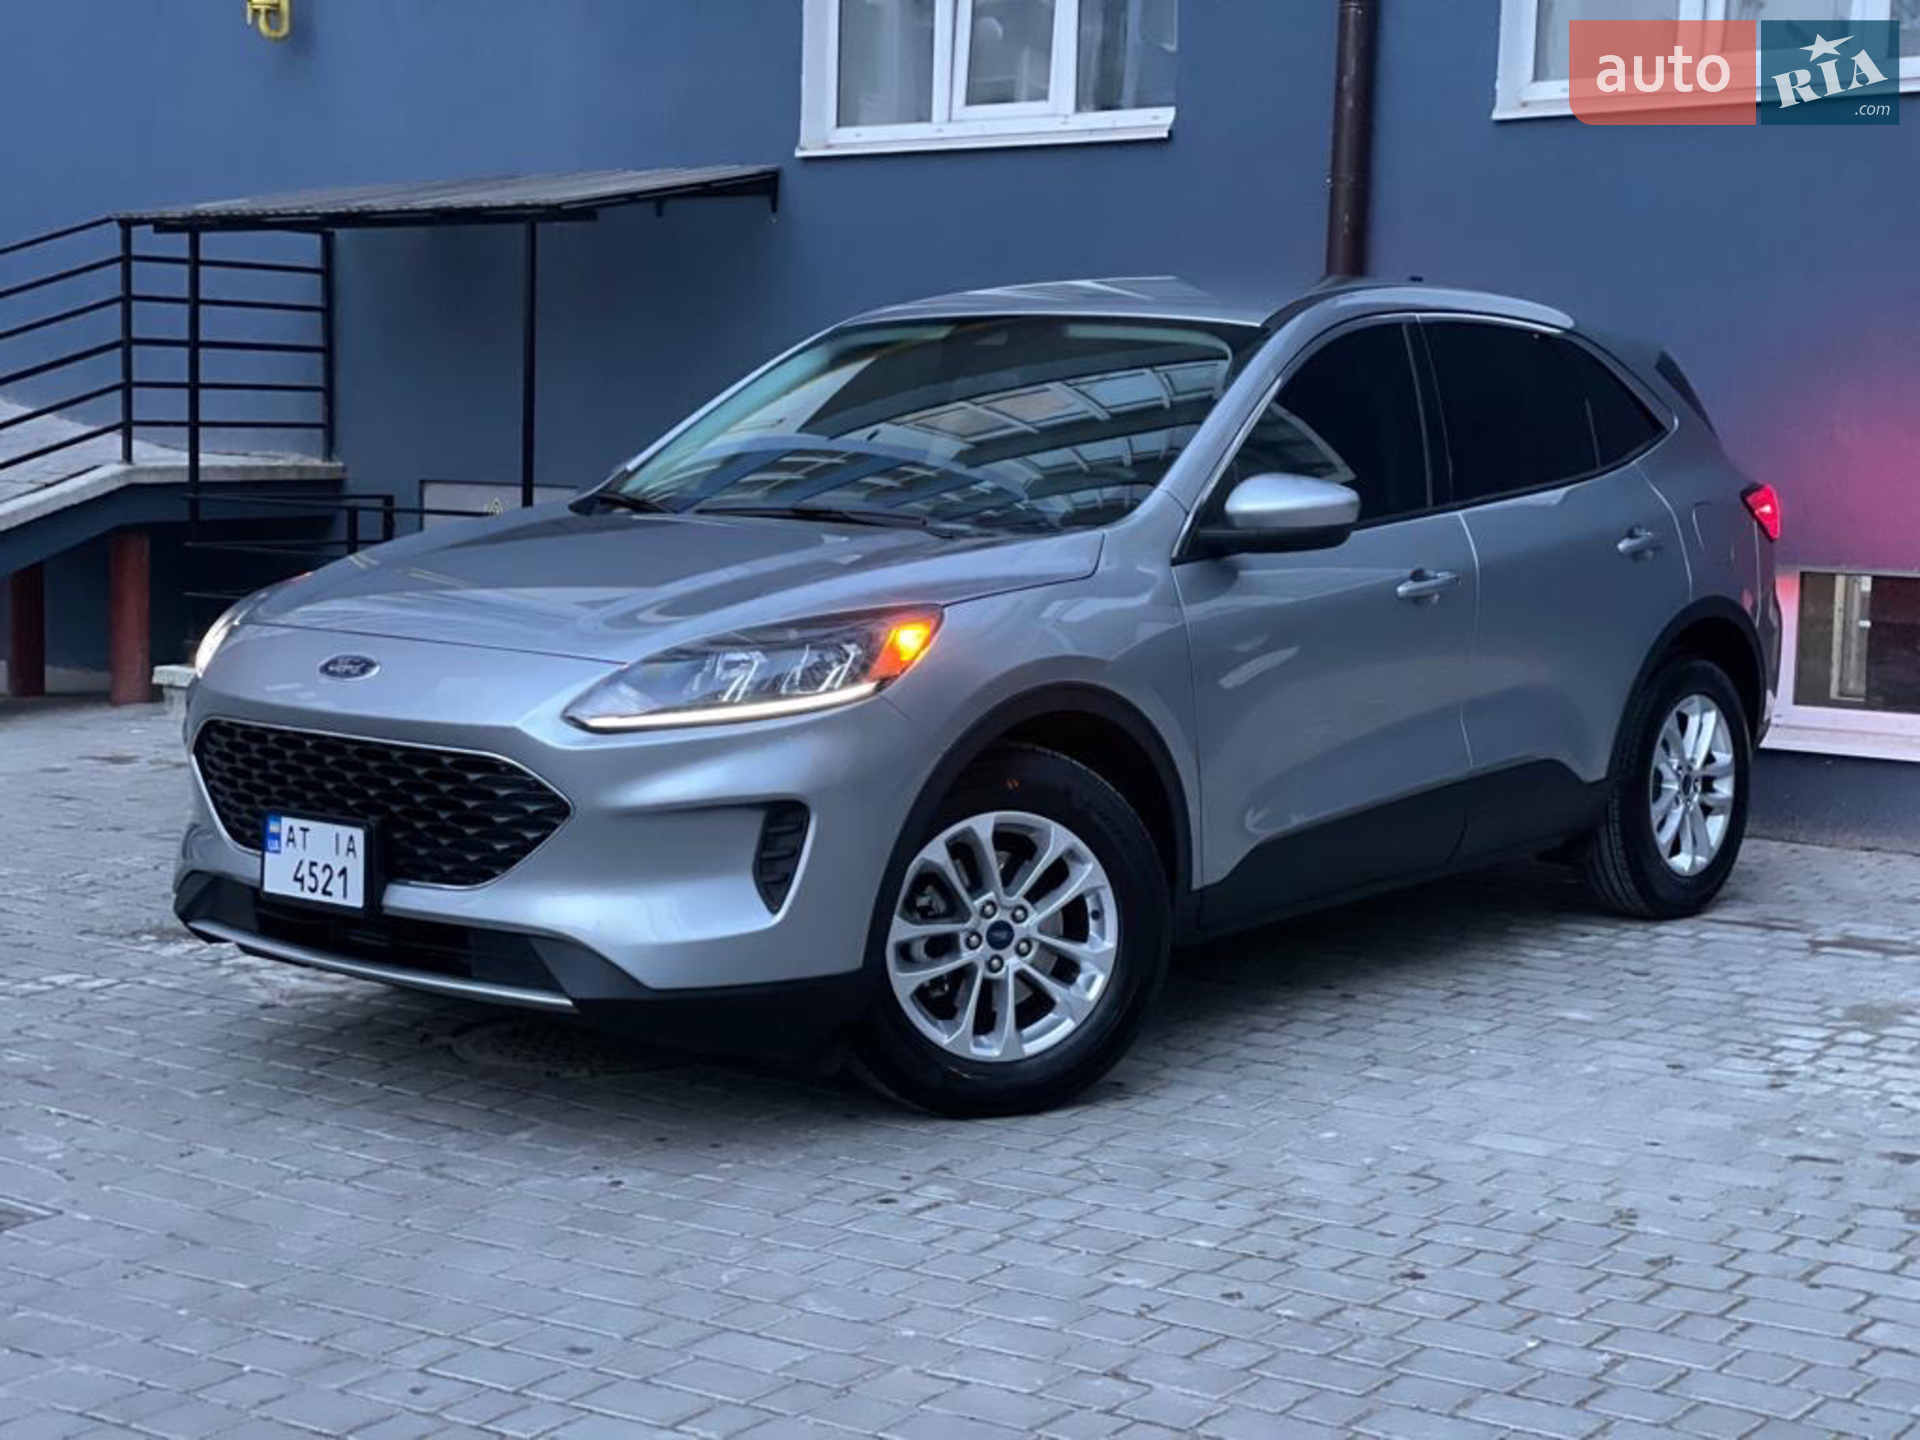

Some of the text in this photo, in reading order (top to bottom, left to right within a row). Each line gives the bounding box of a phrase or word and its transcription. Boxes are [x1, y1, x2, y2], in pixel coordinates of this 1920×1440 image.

[285, 824, 311, 851] AT
[334, 831, 358, 859] IA
[292, 859, 348, 900] 4521
